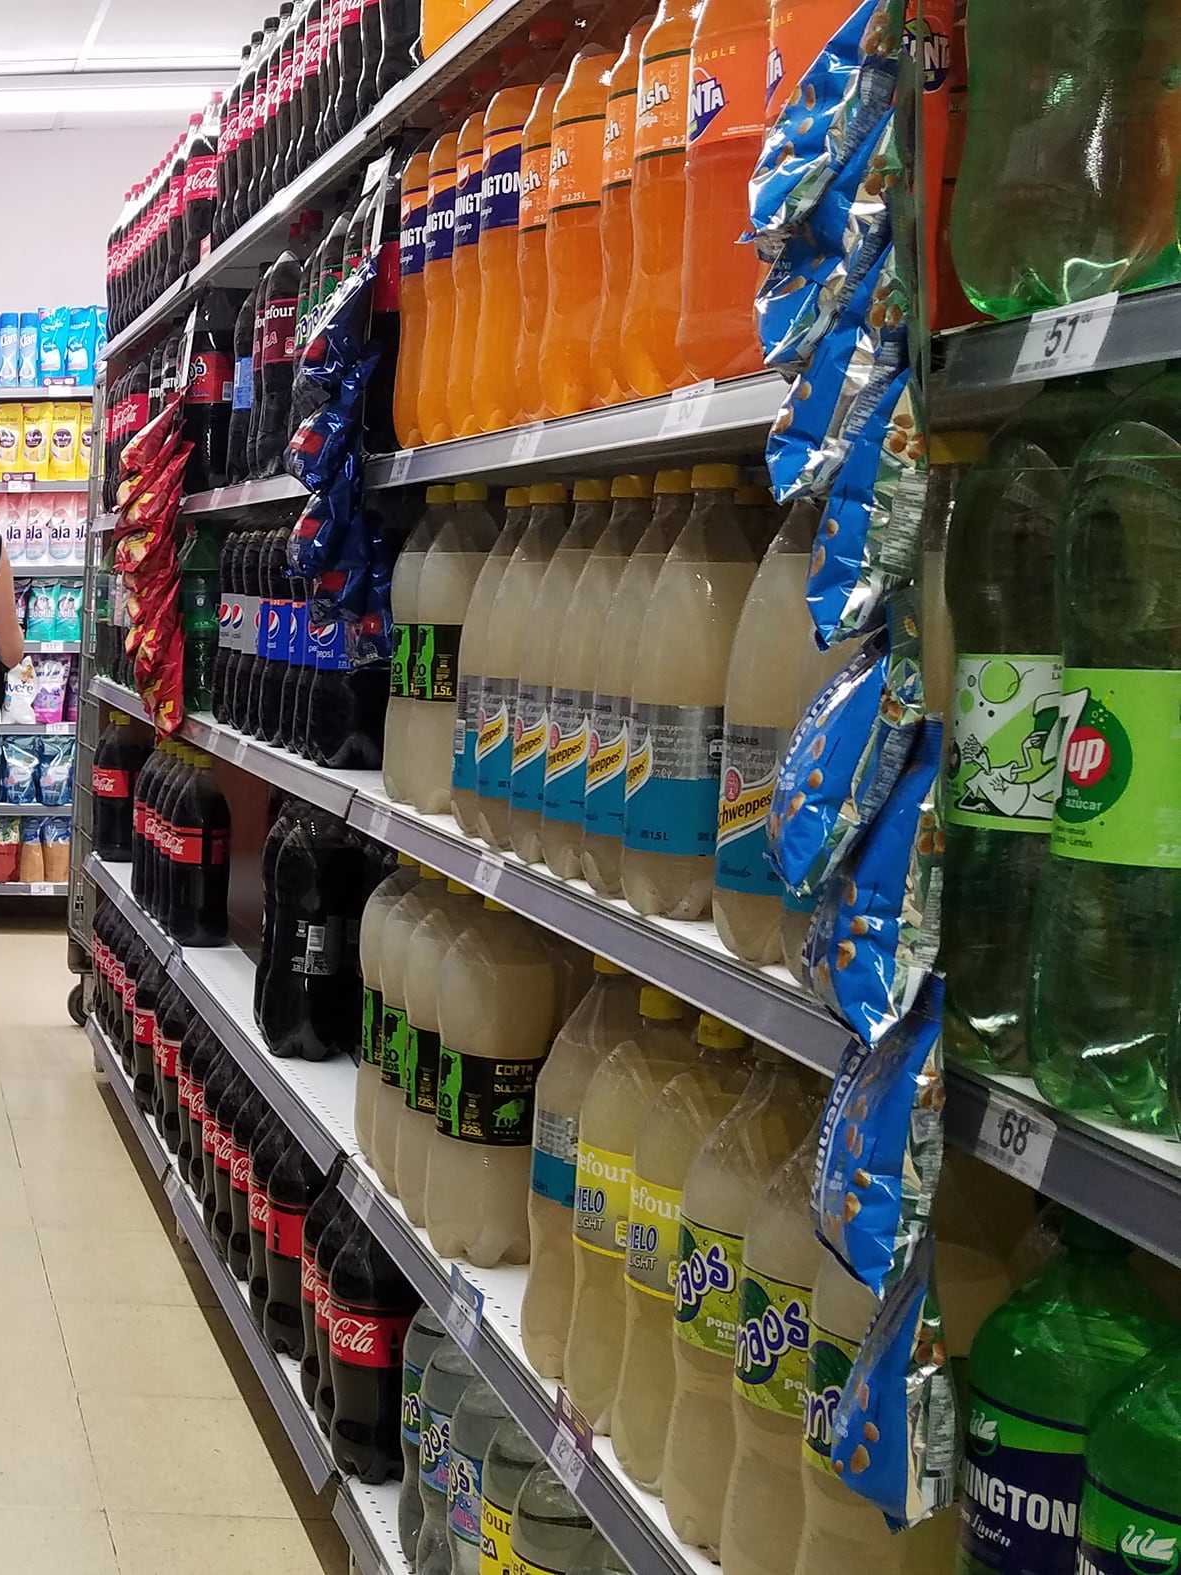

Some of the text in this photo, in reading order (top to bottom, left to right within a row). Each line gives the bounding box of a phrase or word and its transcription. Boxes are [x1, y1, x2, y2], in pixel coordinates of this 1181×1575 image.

[1044, 319, 1081, 357] 51
[51, 525, 71, 540] ala
[1068, 737, 1106, 780] up
[1000, 1109, 1031, 1156] 68
[332, 1316, 378, 1354] Cola
